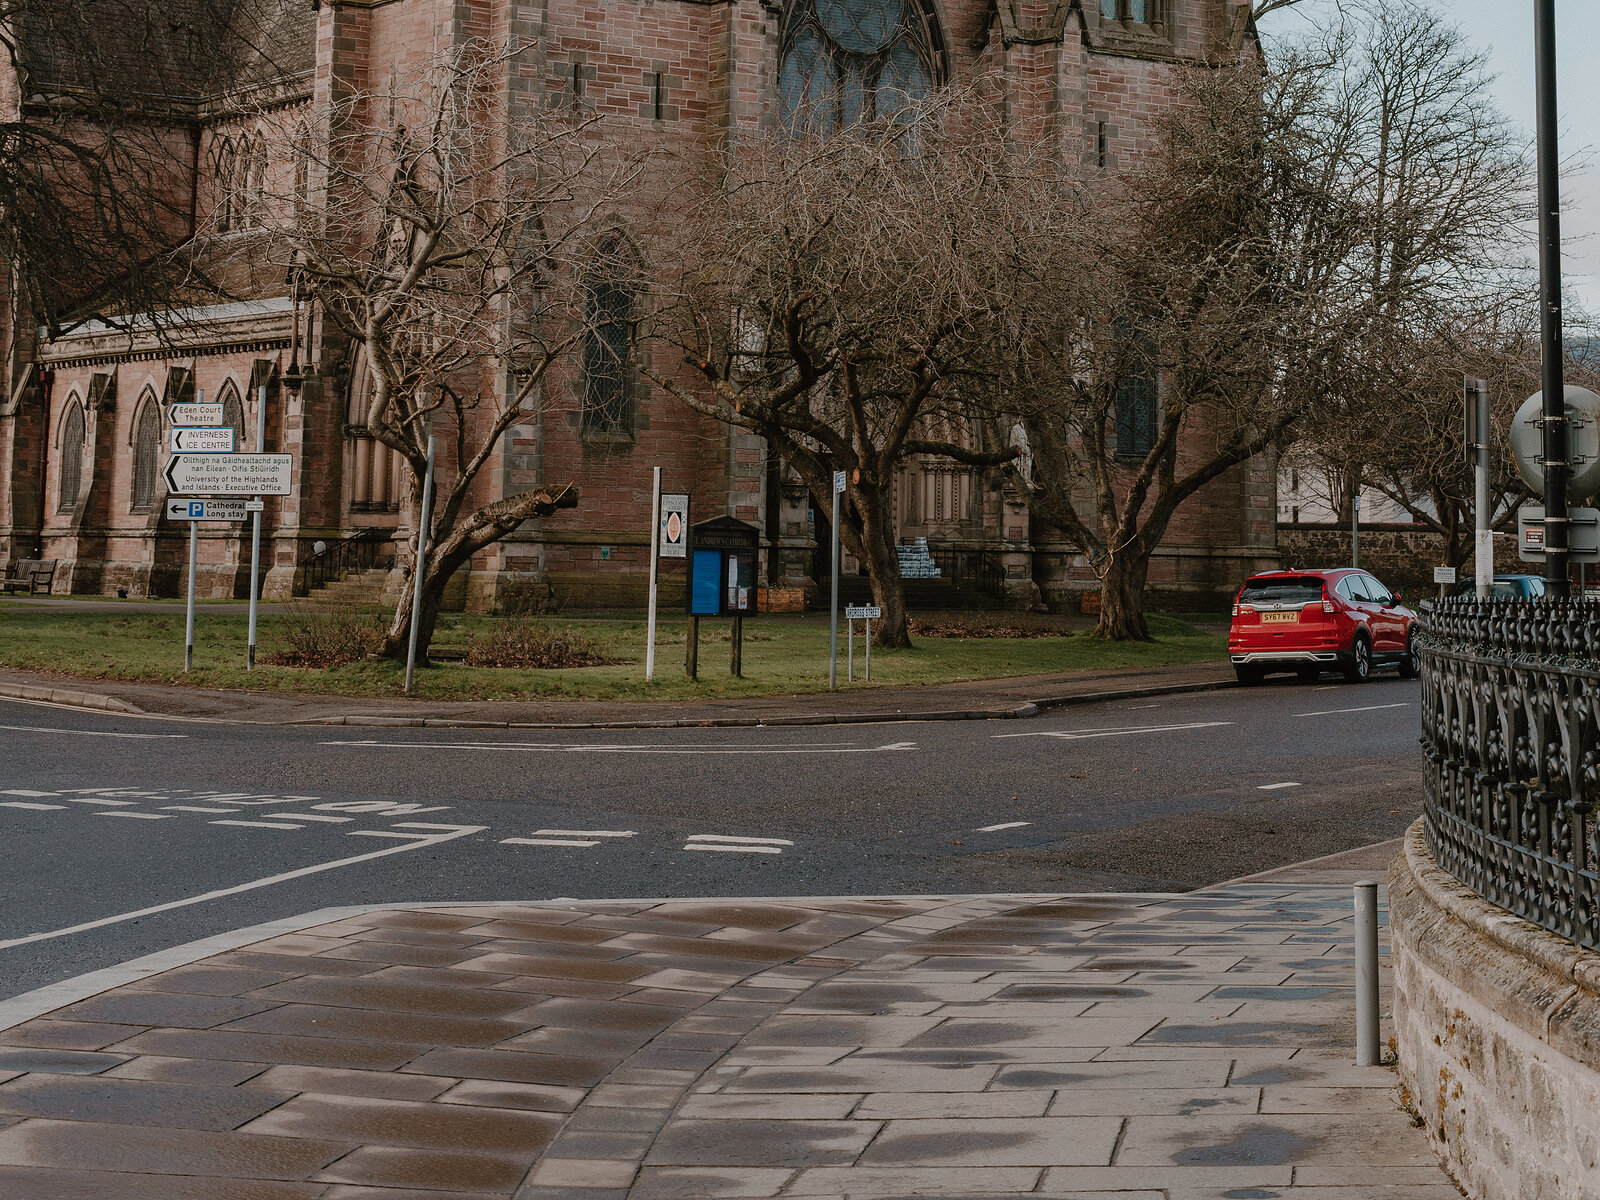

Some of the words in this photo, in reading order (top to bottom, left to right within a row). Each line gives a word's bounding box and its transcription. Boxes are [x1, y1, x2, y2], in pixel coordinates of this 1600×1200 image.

[180, 406, 197, 414] Eden
[199, 406, 221, 414] Court
[188, 431, 229, 439] INVERNESS
[186, 441, 198, 449] ICE
[201, 441, 230, 449] CENTRE
[183, 456, 209, 465] Oilthigh
[185, 475, 219, 483] University
[244, 475, 279, 484] Highlands
[192, 503, 202, 516] P
[206, 510, 225, 518] Long
[1264, 613, 1281, 621] SY67
